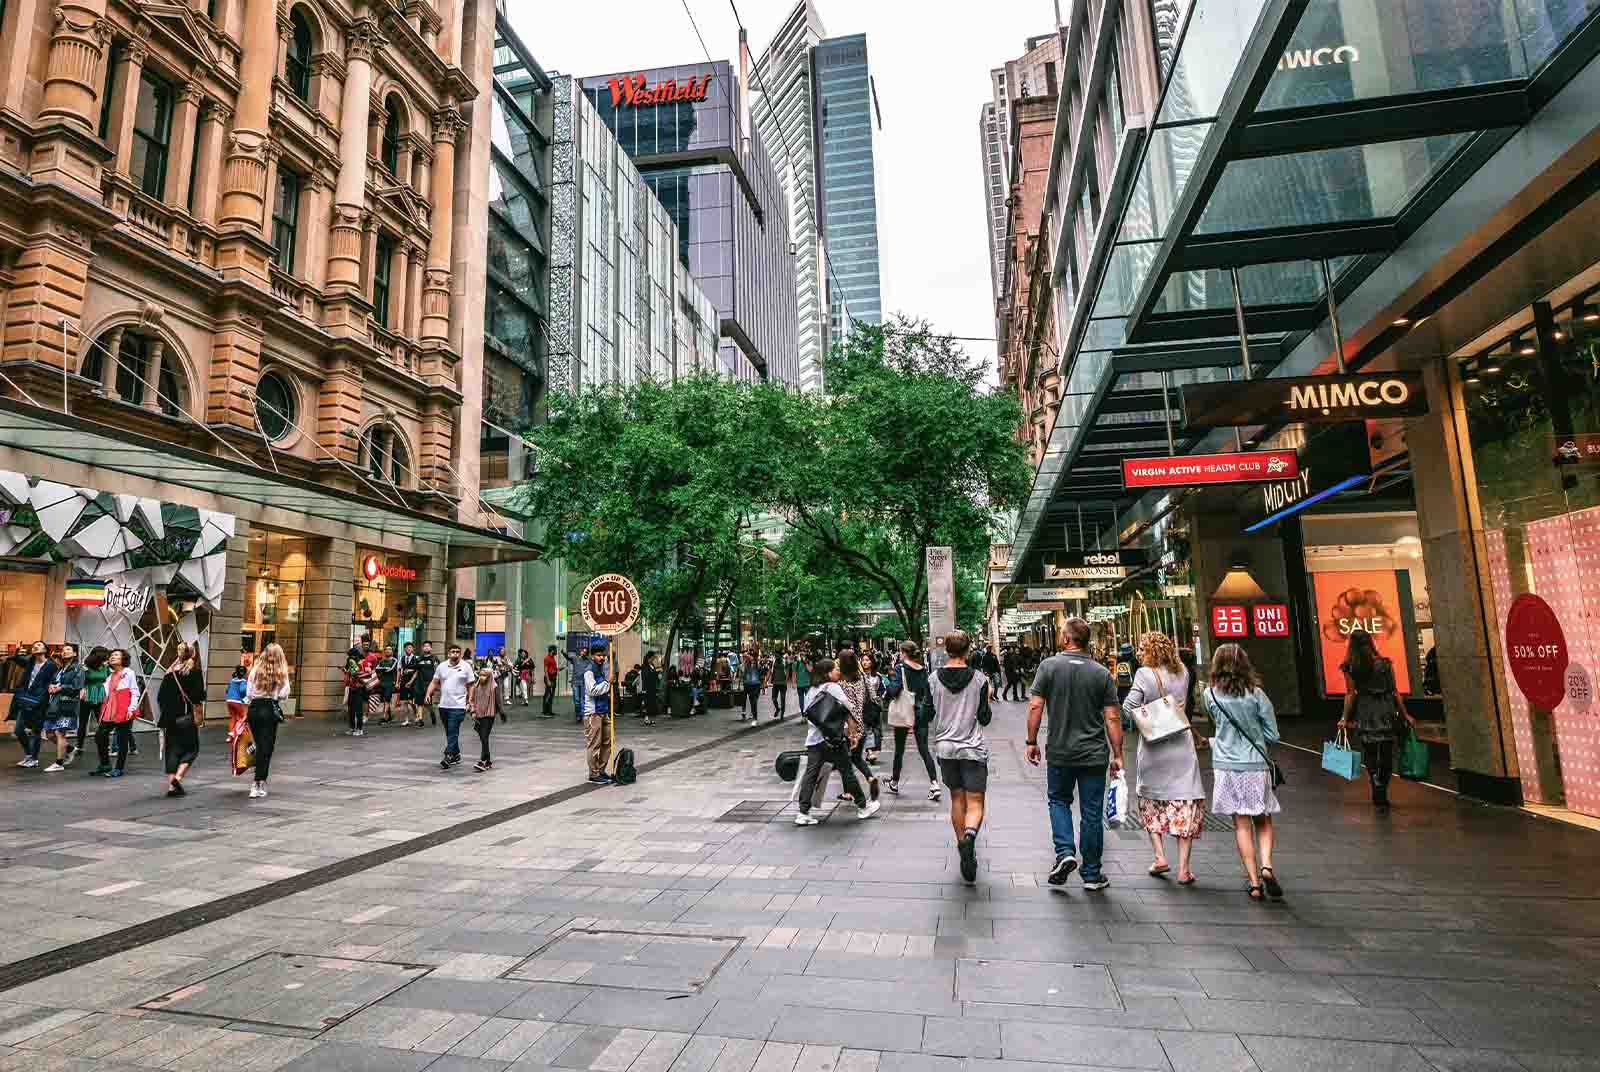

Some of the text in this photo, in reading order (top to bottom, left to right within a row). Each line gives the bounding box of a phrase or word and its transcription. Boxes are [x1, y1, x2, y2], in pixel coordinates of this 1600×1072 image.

[607, 72, 712, 108] Westfield
[1283, 380, 1409, 416] MIMCO
[1132, 467, 1166, 477] VIRGIN
[1169, 465, 1201, 475] ACTIVE
[1204, 463, 1236, 473] HEALTH
[1238, 462, 1261, 471] CLUB
[1264, 467, 1309, 514] MIDCITY
[1083, 551, 1120, 566] rebel
[381, 564, 417, 579] vodafone
[1065, 567, 1119, 575] SWAROVSKI
[591, 577, 605, 589] NOW
[622, 580, 631, 589] TO
[584, 588, 592, 600] ON
[594, 590, 626, 616] UGG
[583, 601, 591, 621] SALE
[630, 607, 638, 621] OFF
[1257, 608, 1281, 620] UNI
[1258, 620, 1285, 634] QLO
[1339, 617, 1383, 634] SALE
[1513, 645, 1559, 658] 50% OFF
[1570, 687, 1589, 698] OFF
